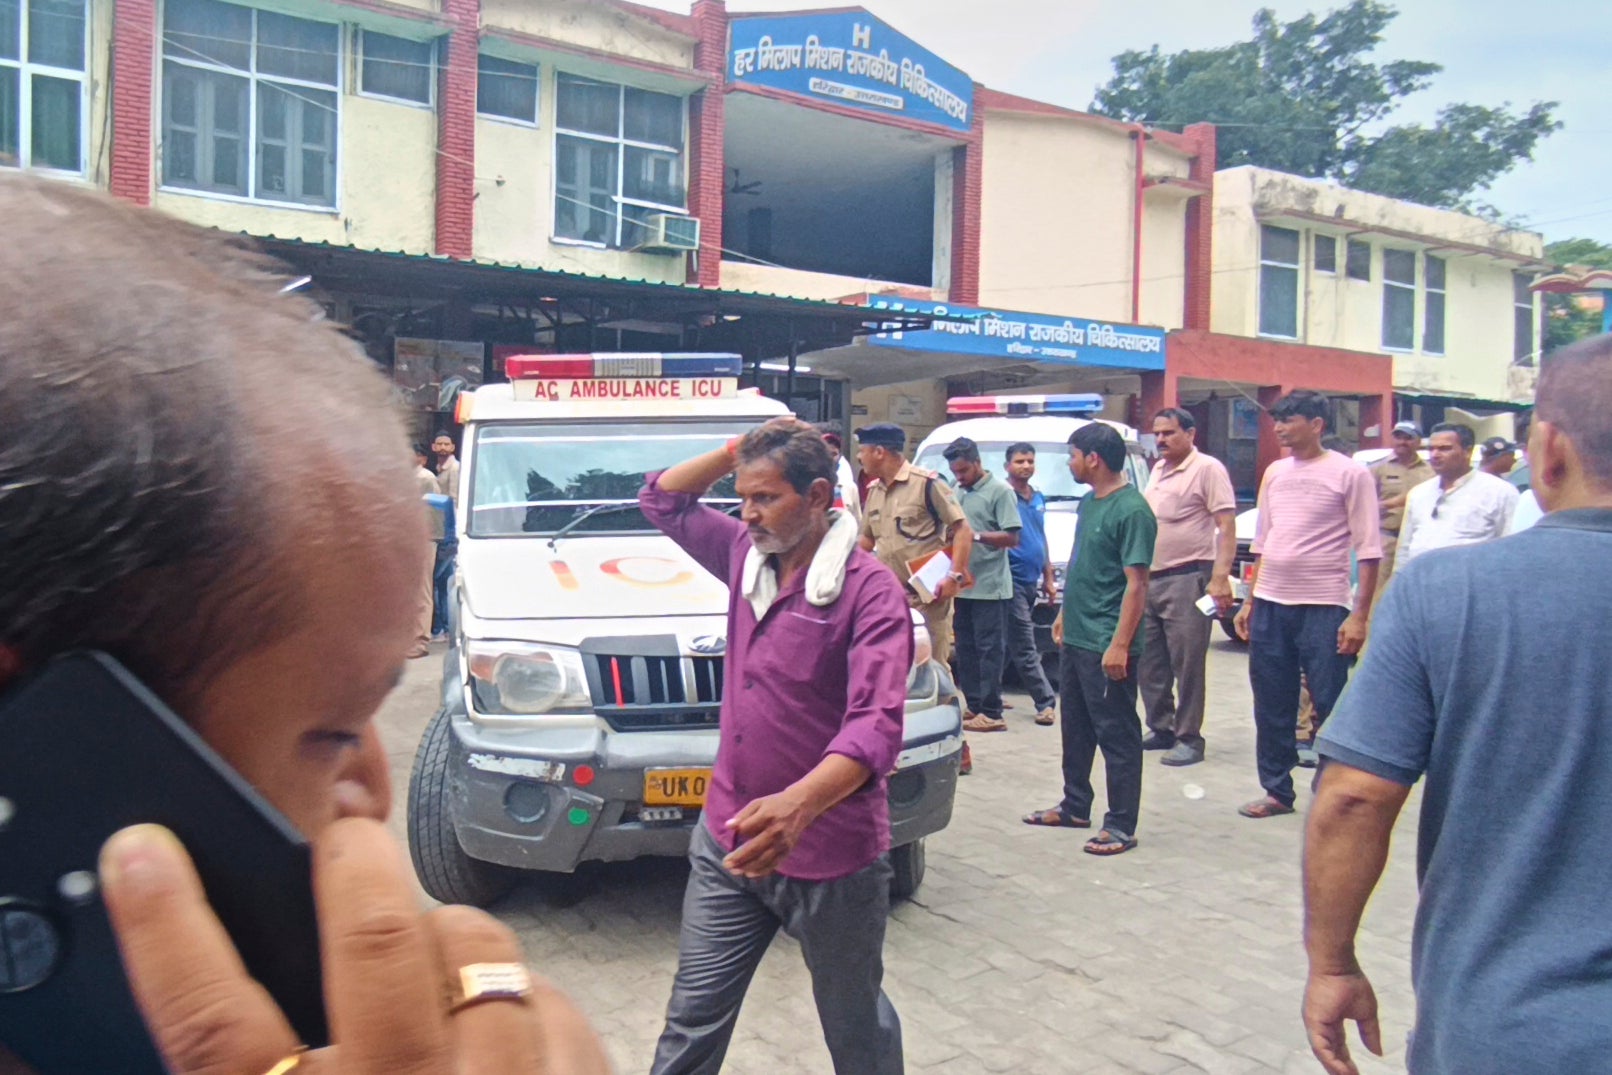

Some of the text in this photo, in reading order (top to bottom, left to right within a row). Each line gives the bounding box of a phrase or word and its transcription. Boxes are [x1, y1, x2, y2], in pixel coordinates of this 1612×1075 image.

[852, 23, 870, 48] H
[734, 35, 967, 123] हर मिलाप मिशन राजकीय चिकित्सालय
[1028, 320, 1085, 345] राजकीय
[1087, 323, 1161, 353] चिकित्सालय
[535, 380, 722, 398] AC AMBULANCE ICU
